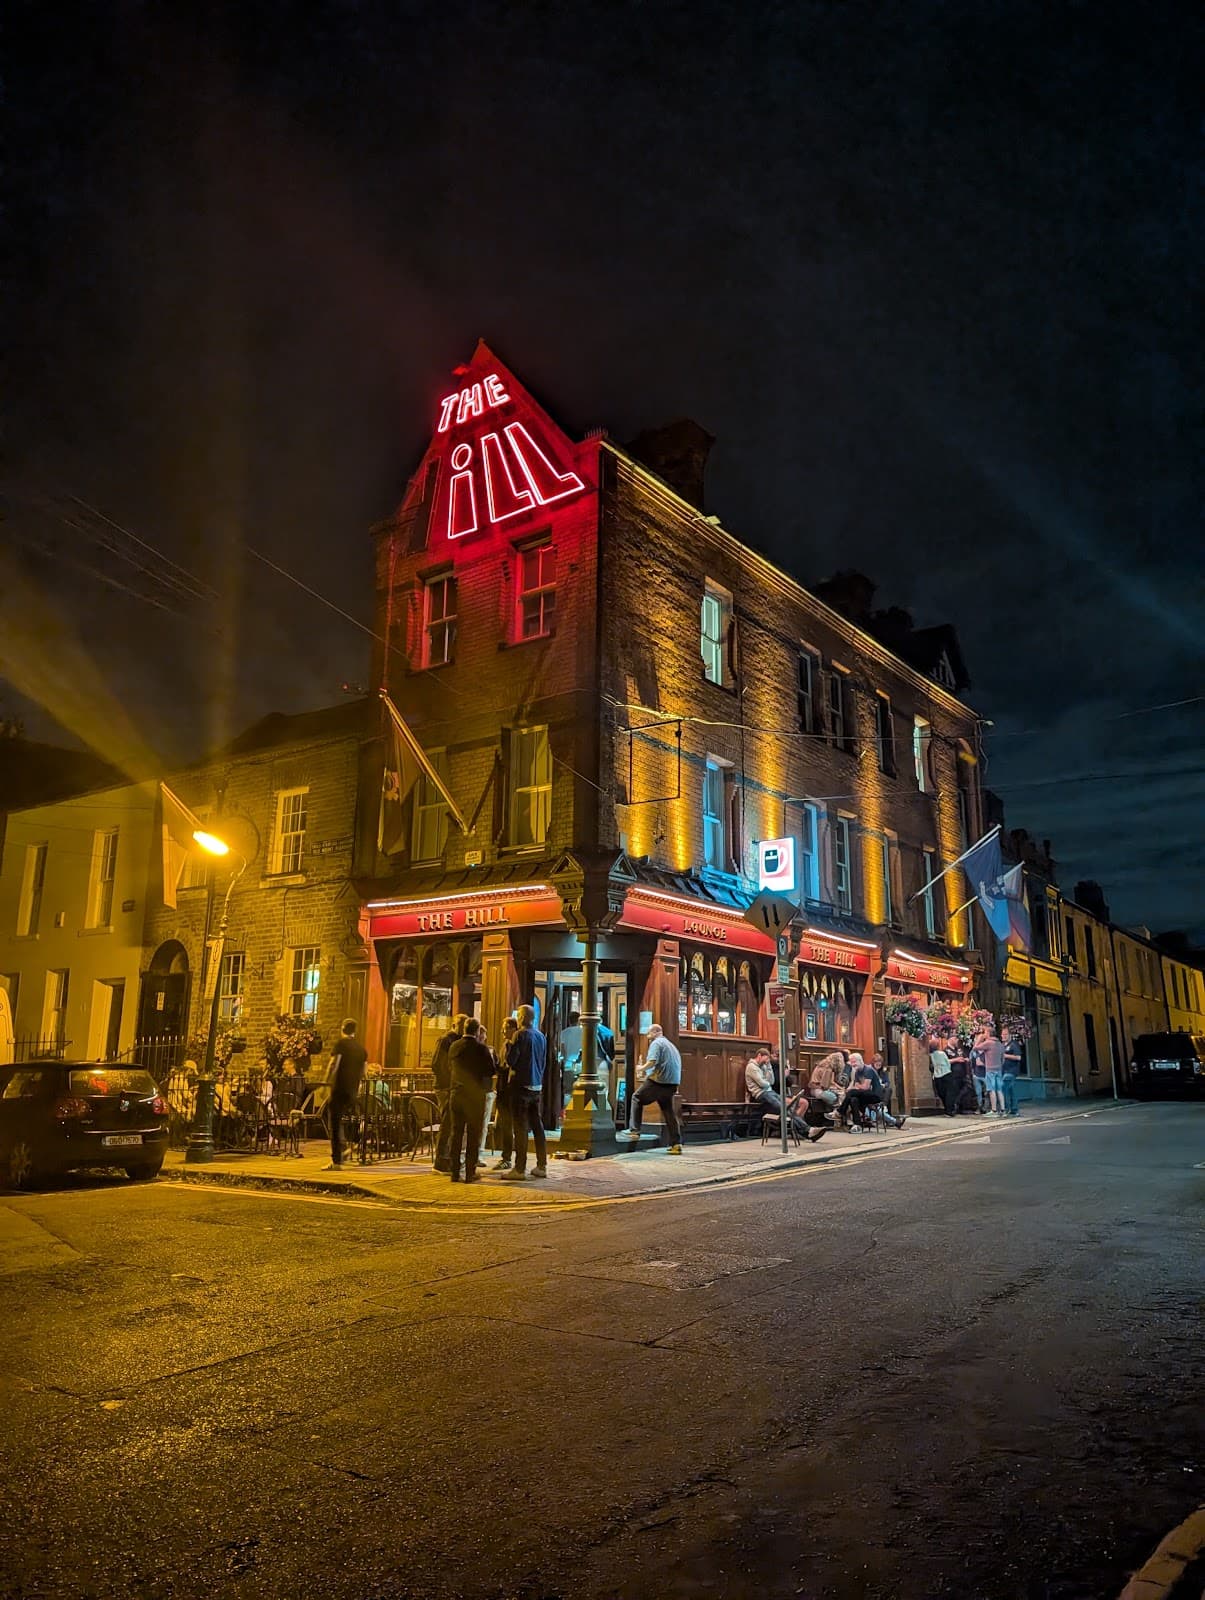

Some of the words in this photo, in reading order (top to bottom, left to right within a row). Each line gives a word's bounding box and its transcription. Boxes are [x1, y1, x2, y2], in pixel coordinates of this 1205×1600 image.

[438, 374, 510, 433] THE
[417, 913, 454, 932] THE
[464, 906, 509, 928] HILL
[683, 919, 727, 940] LOUNGE
[810, 945, 831, 962] THE
[834, 951, 857, 967] HILL
